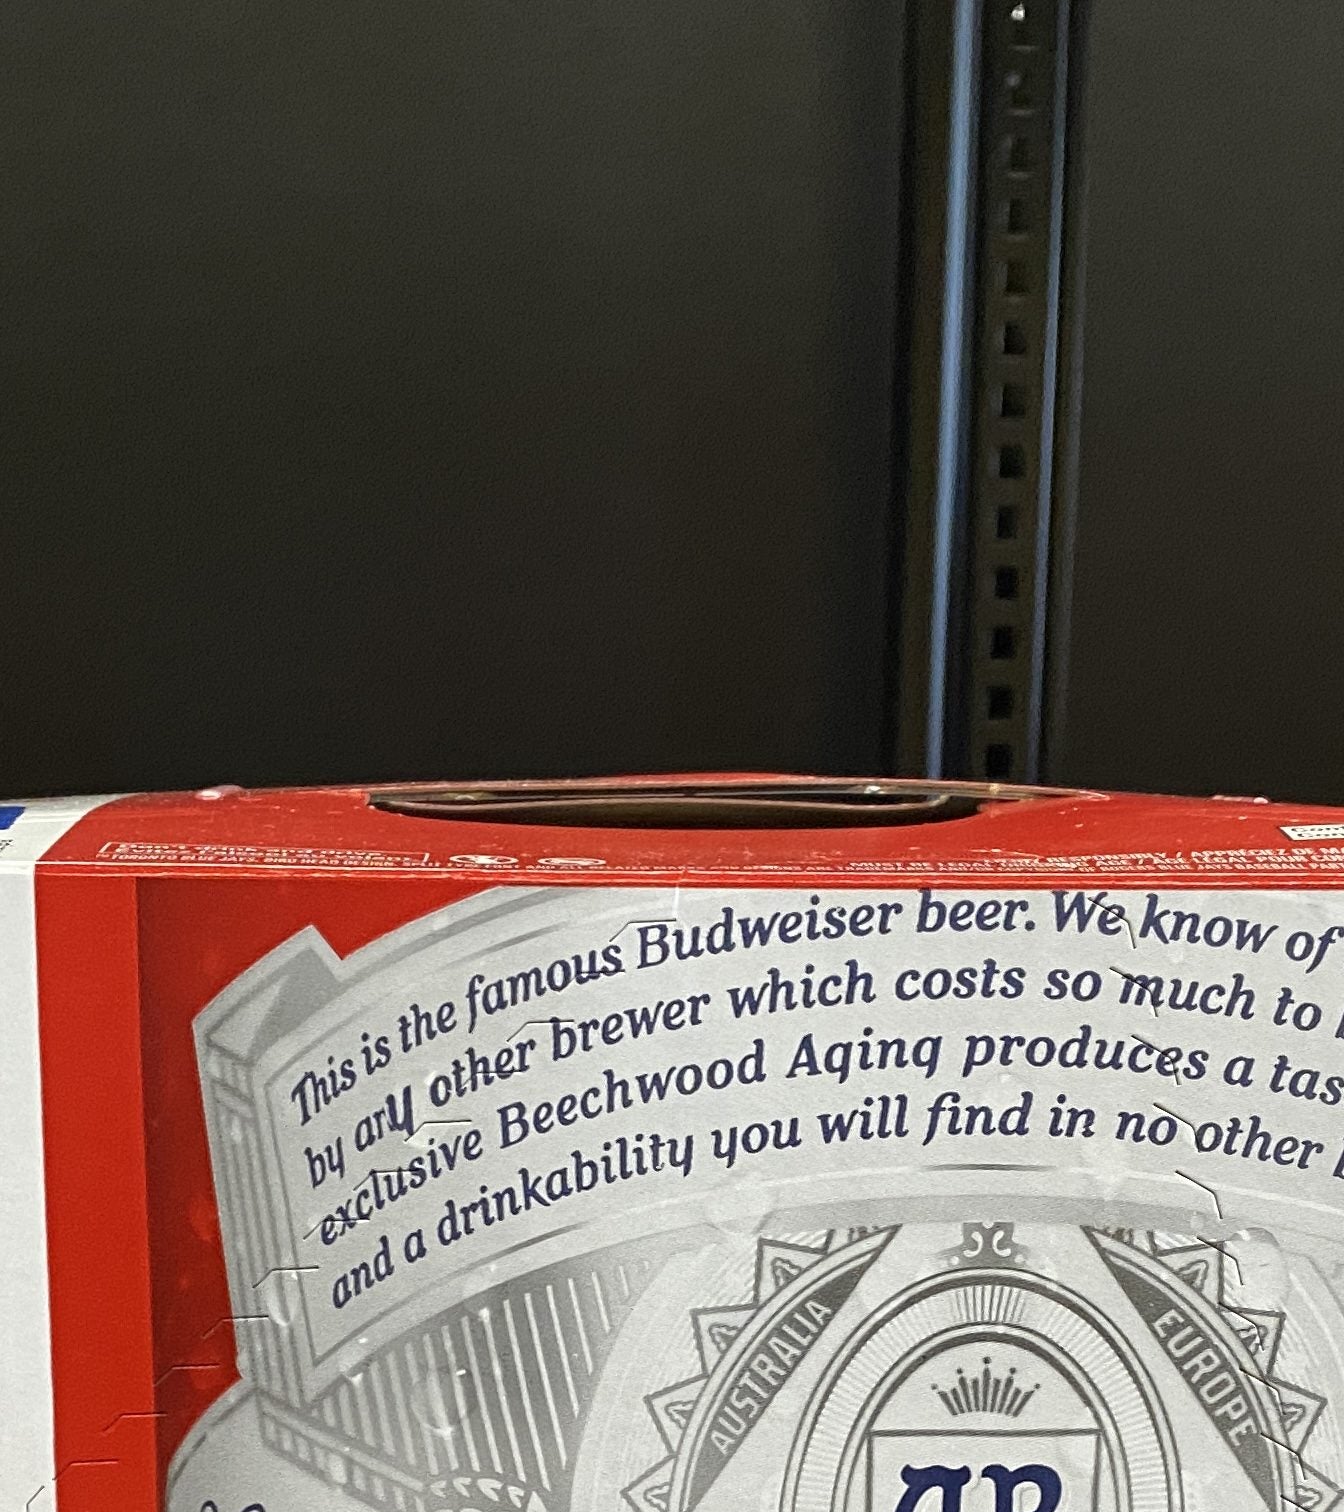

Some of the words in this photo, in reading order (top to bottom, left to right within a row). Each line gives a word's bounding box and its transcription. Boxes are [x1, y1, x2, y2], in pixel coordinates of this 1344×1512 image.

[292, 1056, 356, 1126] This
[360, 1032, 391, 1078] is
[398, 994, 457, 1049] the
[465, 940, 623, 1032] famous
[636, 896, 902, 970] Budweiser
[916, 889, 1035, 932] beer.
[1052, 888, 1127, 937] We
[1139, 893, 1278, 954] know
[1284, 924, 1344, 974] of
[305, 1136, 345, 1188] by
[429, 1033, 536, 1108] other
[550, 989, 712, 1062] brewer
[729, 960, 875, 1017] which
[894, 958, 1024, 1001] costs
[1043, 967, 1101, 1003] so
[1117, 966, 1256, 1021] much
[1274, 988, 1321, 1033] to
[318, 1121, 485, 1246] exclusive
[496, 1038, 767, 1151] Beechwood
[784, 1029, 944, 1089] Aging
[963, 1026, 1208, 1081] produces
[1223, 1053, 1254, 1087] a
[332, 1237, 396, 1308] and
[403, 1228, 428, 1264] a
[436, 1132, 695, 1246] drinkability
[710, 1121, 802, 1169] you
[817, 1095, 908, 1140] will
[921, 1092, 1030, 1146] find
[1049, 1095, 1096, 1138] in
[1116, 1108, 1179, 1146] no
[1193, 1115, 1324, 1172] other
[710, 1299, 834, 1456] AUSTRALIA
[1152, 1310, 1257, 1447] EUROPE
